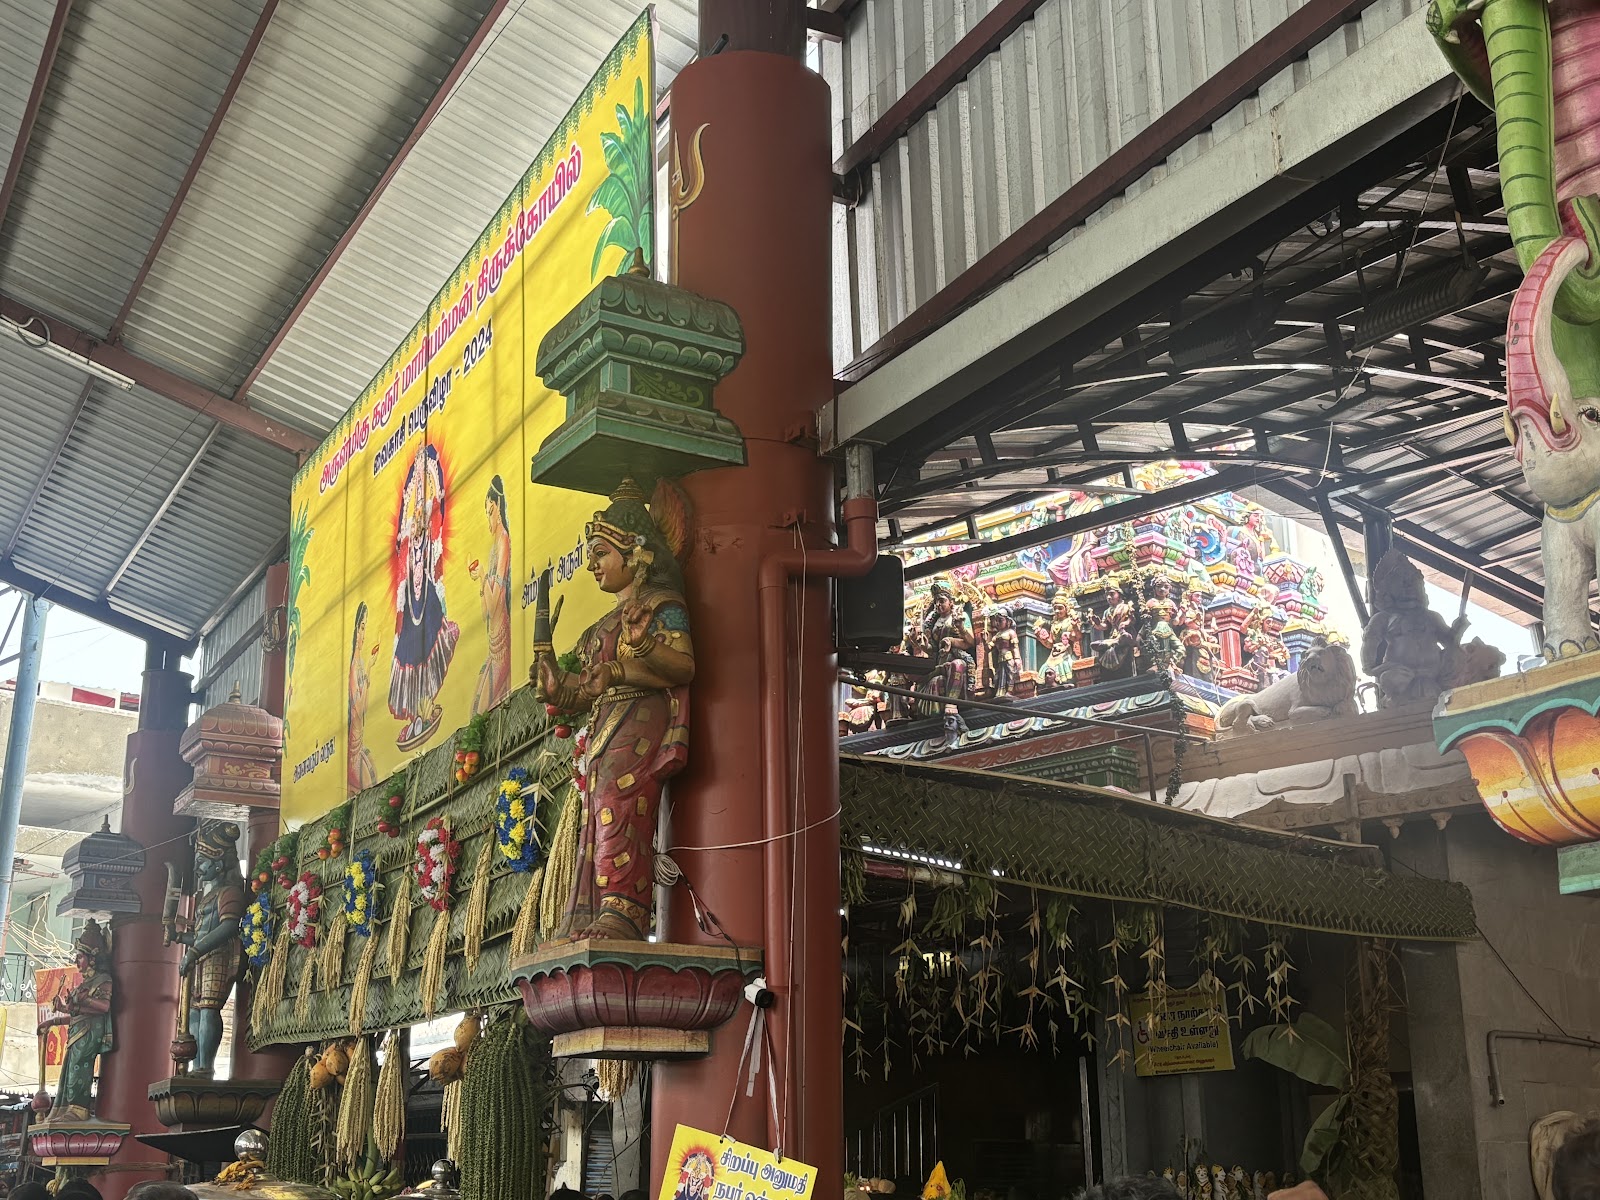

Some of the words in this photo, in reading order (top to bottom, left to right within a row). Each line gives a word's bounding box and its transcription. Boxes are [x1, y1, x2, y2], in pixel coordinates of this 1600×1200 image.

[320, 416, 369, 494] அருள்மிகு
[371, 371, 400, 430] கரூர்
[401, 282, 474, 395] மாரியம்மன்
[476, 145, 581, 313] திருக்கோயில்
[373, 415, 406, 476] வைகாசி
[408, 367, 452, 437] பெருவிழா
[463, 317, 493, 374] 2024
[521, 556, 555, 610] அம்ன்
[557, 533, 584, 583] அருள்
[720, 1147, 760, 1180] சிறப்பு
[760, 1163, 808, 1196] அனுமதி
